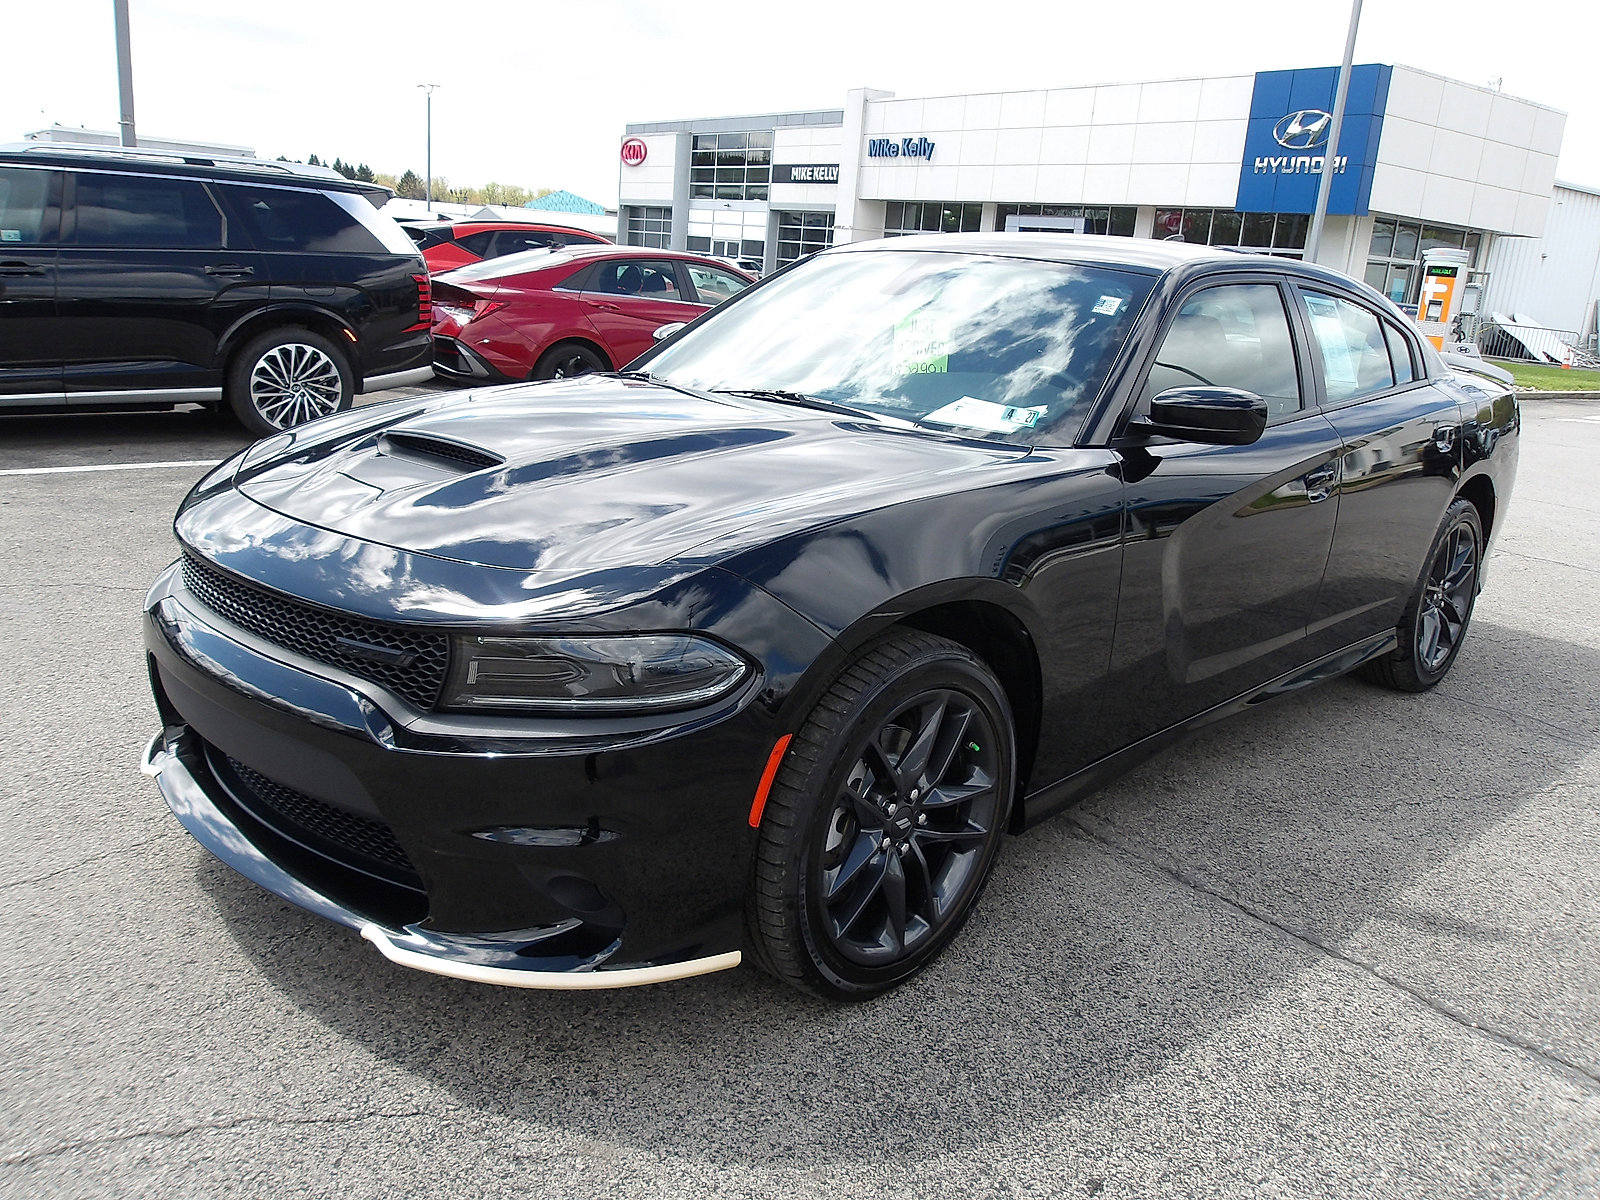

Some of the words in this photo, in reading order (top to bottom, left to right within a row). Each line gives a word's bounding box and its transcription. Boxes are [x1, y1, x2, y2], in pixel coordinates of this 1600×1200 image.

[622, 144, 643, 160] KIA
[868, 138, 900, 158] Mike
[901, 137, 936, 161] Kelly
[791, 167, 813, 181] MIKE
[813, 166, 839, 181] KELLY
[909, 318, 937, 334] JUST
[1025, 411, 1037, 424] 27
